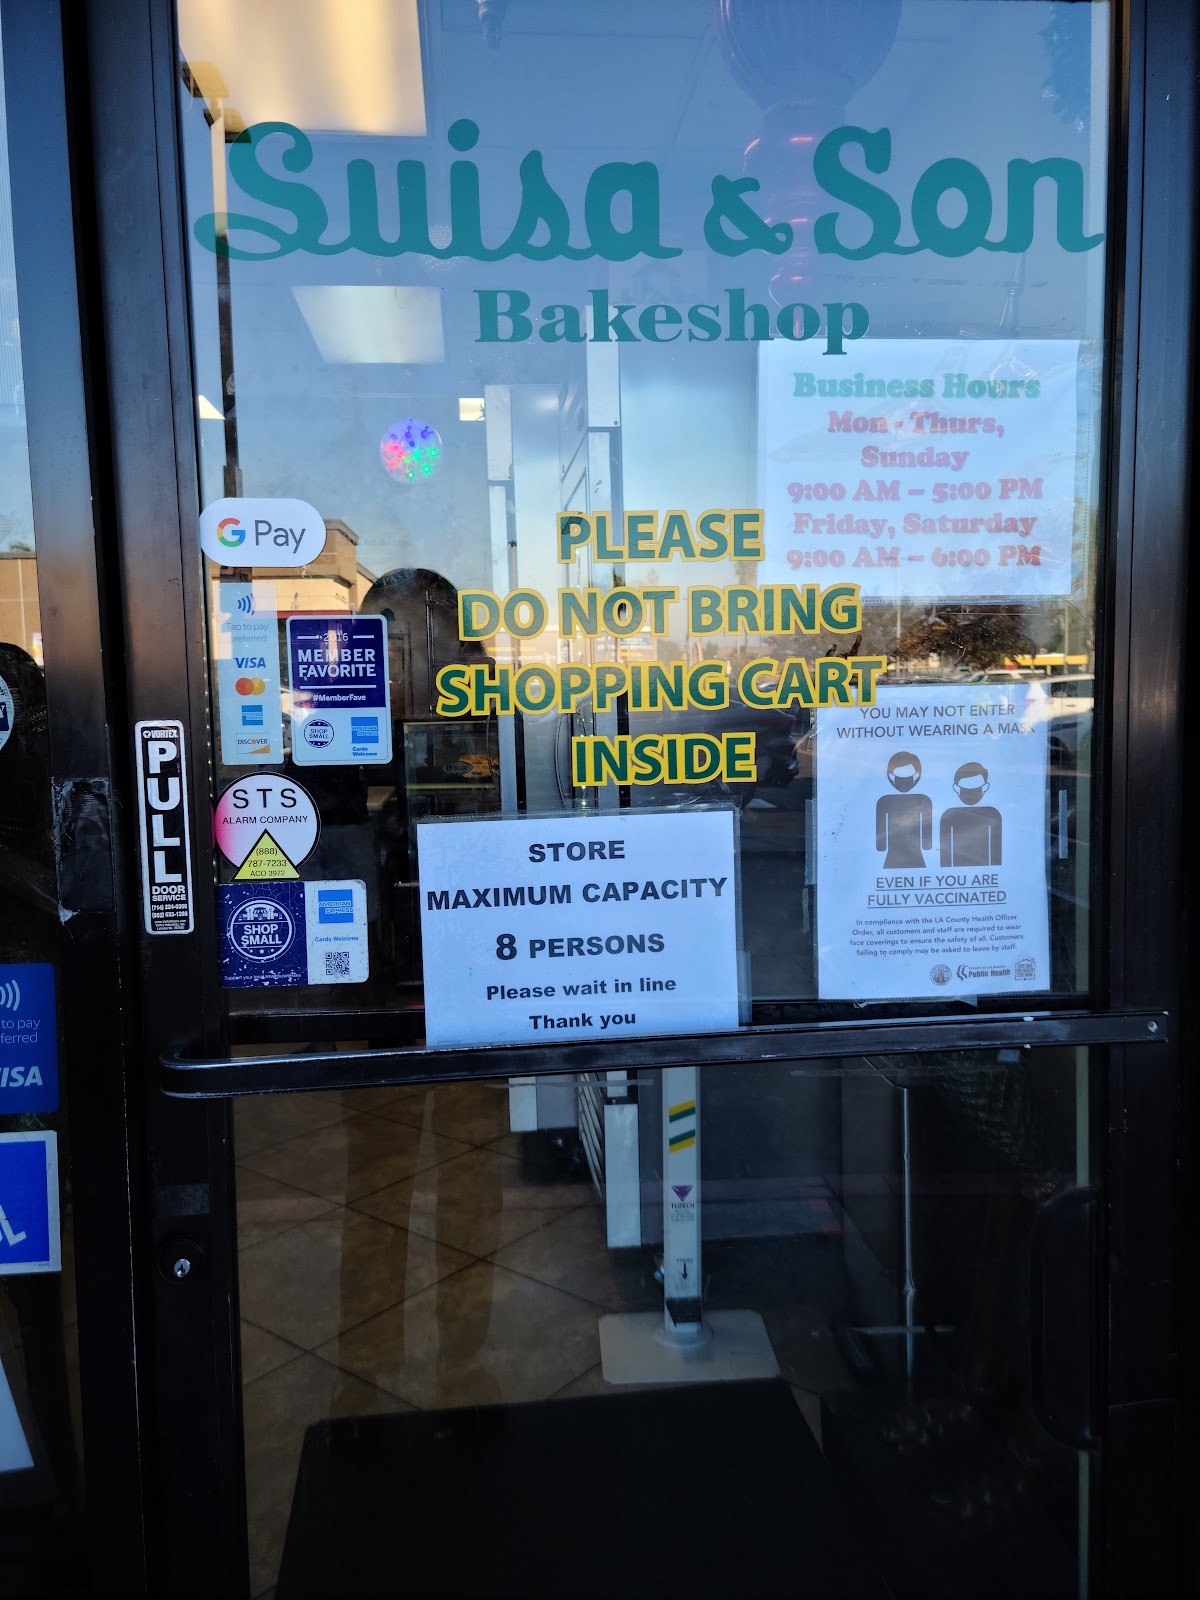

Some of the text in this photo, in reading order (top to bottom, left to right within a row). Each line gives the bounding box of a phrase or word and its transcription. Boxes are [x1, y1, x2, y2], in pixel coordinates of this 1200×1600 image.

[194, 119, 1105, 261] Suisa & Son
[474, 288, 869, 355] Bakeshop
[793, 372, 1040, 399] Business Hours
[828, 411, 888, 433] Mon
[910, 411, 1005, 437] Thurs,
[861, 445, 969, 472] Sunday
[787, 482, 846, 503] 9:00
[852, 480, 901, 501] AM
[932, 481, 991, 503] 5:00
[999, 477, 1043, 500] PM
[793, 512, 1037, 539] Friday, Saturday
[216, 517, 306, 554] G Pay
[556, 509, 765, 564] PLEASE
[786, 549, 846, 570] 9:00
[852, 546, 901, 568] AM
[931, 546, 990, 568] 6:00
[998, 544, 1041, 567] PM
[458, 582, 862, 641] DO NOT BRING
[226, 622, 268, 633] Tap to pay
[323, 633, 348, 642] 2016
[234, 657, 266, 668] VISA
[298, 648, 375, 662] MEMBER
[299, 664, 376, 678] FAVORITE
[435, 656, 887, 717] SHOPPING CART
[313, 693, 366, 701] #MemberFave
[860, 703, 1015, 720] YOU MAY NOT ENTER
[151, 729, 179, 738] VORTEX
[836, 725, 904, 739] WITHOUT
[908, 723, 978, 737] WEARING
[983, 723, 993, 735] A
[571, 732, 757, 788] INSIDE
[147, 741, 182, 884] PULL
[222, 815, 309, 825] ALARM COMPANY
[255, 847, 278, 856] (888)
[528, 840, 625, 863] STORE
[247, 859, 287, 867] 787-7233
[876, 874, 999, 889] EVEN IF YOU ARE
[151, 885, 185, 895] DOOR
[427, 877, 727, 911] MAXIMUM CAPACITY
[868, 890, 1006, 906] FULLY VACCINATED
[243, 924, 279, 935] SHOP
[864, 918, 904, 927] compliance
[945, 916, 970, 925] County
[852, 929, 874, 937] Order,
[876, 928, 885, 936] all
[966, 925, 995, 933] required
[241, 935, 282, 946] SMALL
[496, 933, 664, 960] 8 PERSONS
[866, 938, 899, 947] coverings
[947, 935, 968, 944] safety
[990, 933, 1024, 941] Customers
[856, 949, 877, 957] failing
[888, 948, 913, 957] comply
[930, 946, 939, 954] be
[991, 944, 999, 953] by
[969, 969, 1011, 978] Public Health
[486, 977, 677, 1001] Please wait in line
[1, 1019, 40, 1030] to pay
[528, 1013, 636, 1030] Thank you
[0, 1066, 43, 1088] ISA
